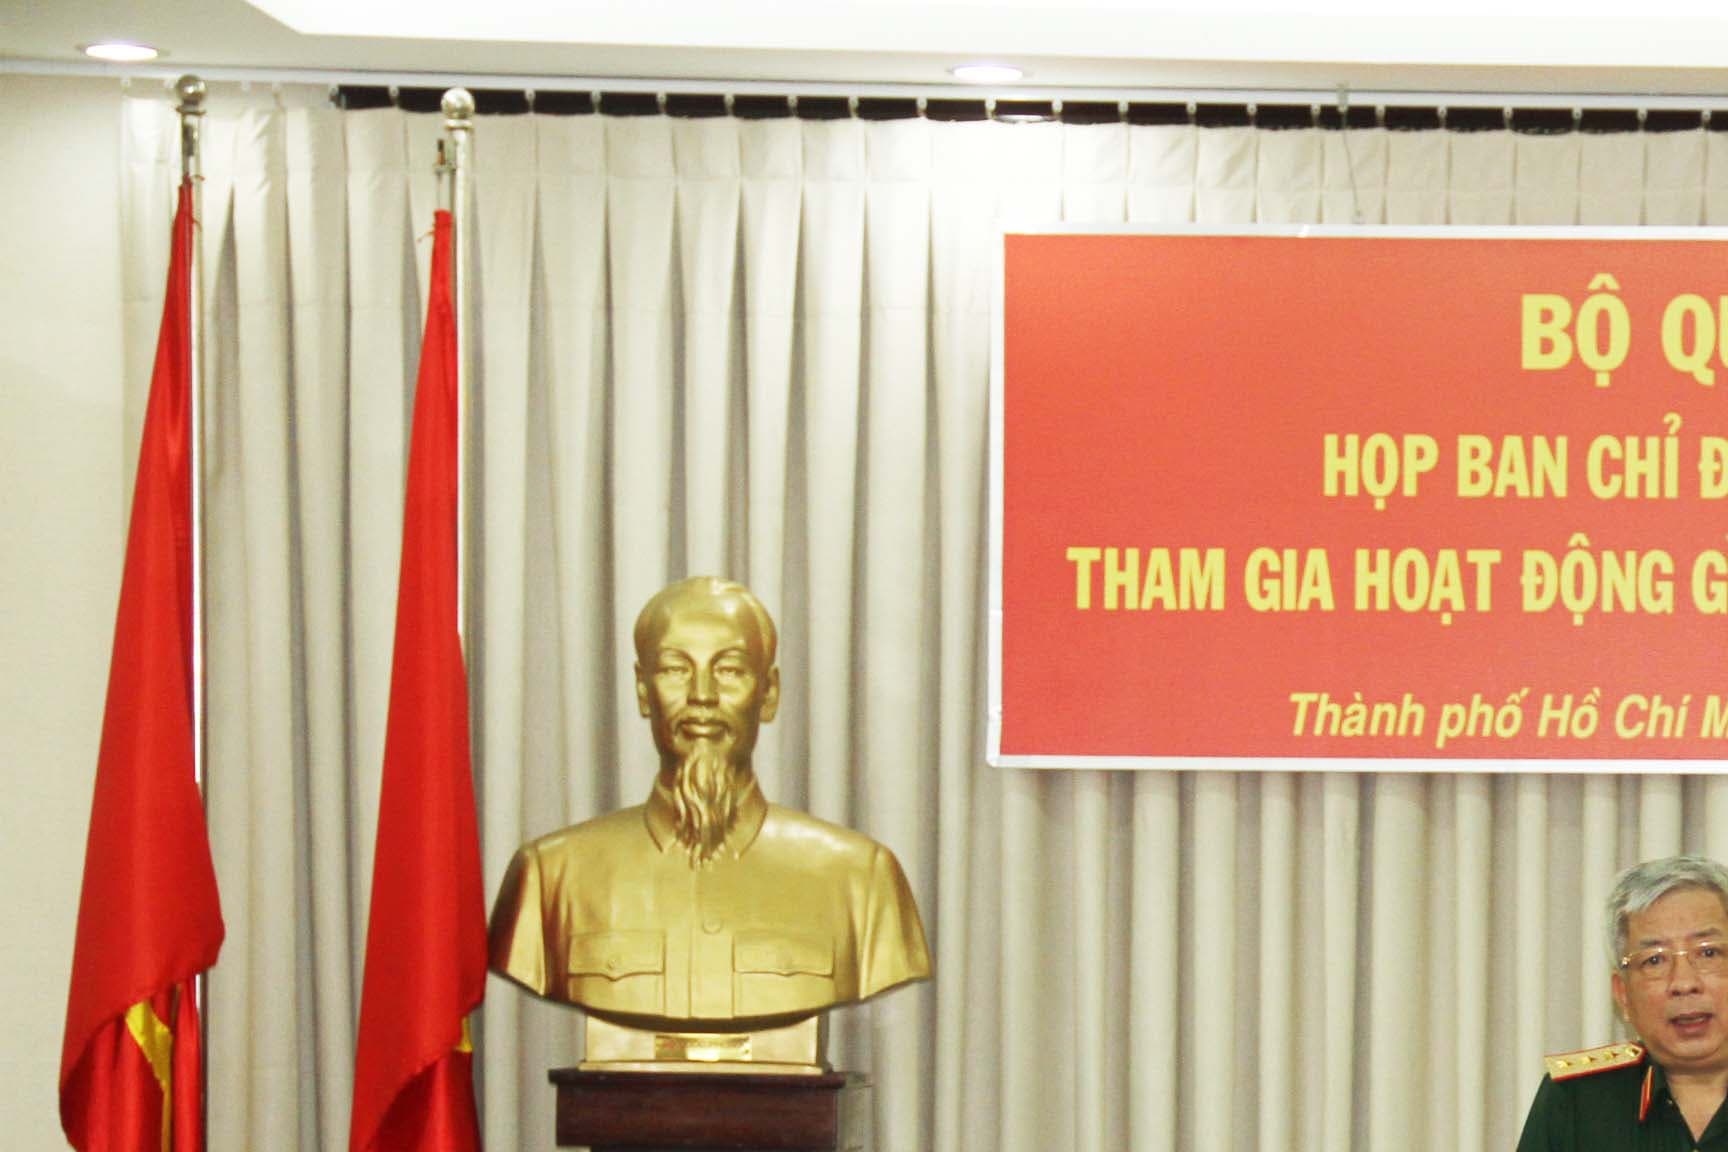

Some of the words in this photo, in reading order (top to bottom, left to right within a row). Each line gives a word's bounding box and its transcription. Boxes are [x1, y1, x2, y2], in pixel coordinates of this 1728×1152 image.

[1520, 272, 1631, 388] BỘ
[1323, 432, 1439, 511] HỌP
[1457, 434, 1569, 498] BAN
[1586, 412, 1683, 500] CHỈ
[1066, 546, 1226, 611] THAM
[1244, 547, 1335, 612] GIA
[1354, 547, 1502, 626] HOẠT
[1519, 532, 1675, 627] ĐỘNG
[1289, 692, 1425, 737] Thành
[1436, 687, 1531, 749] phố
[1537, 687, 1601, 738] Hồ
[1615, 694, 1691, 739] Chí
